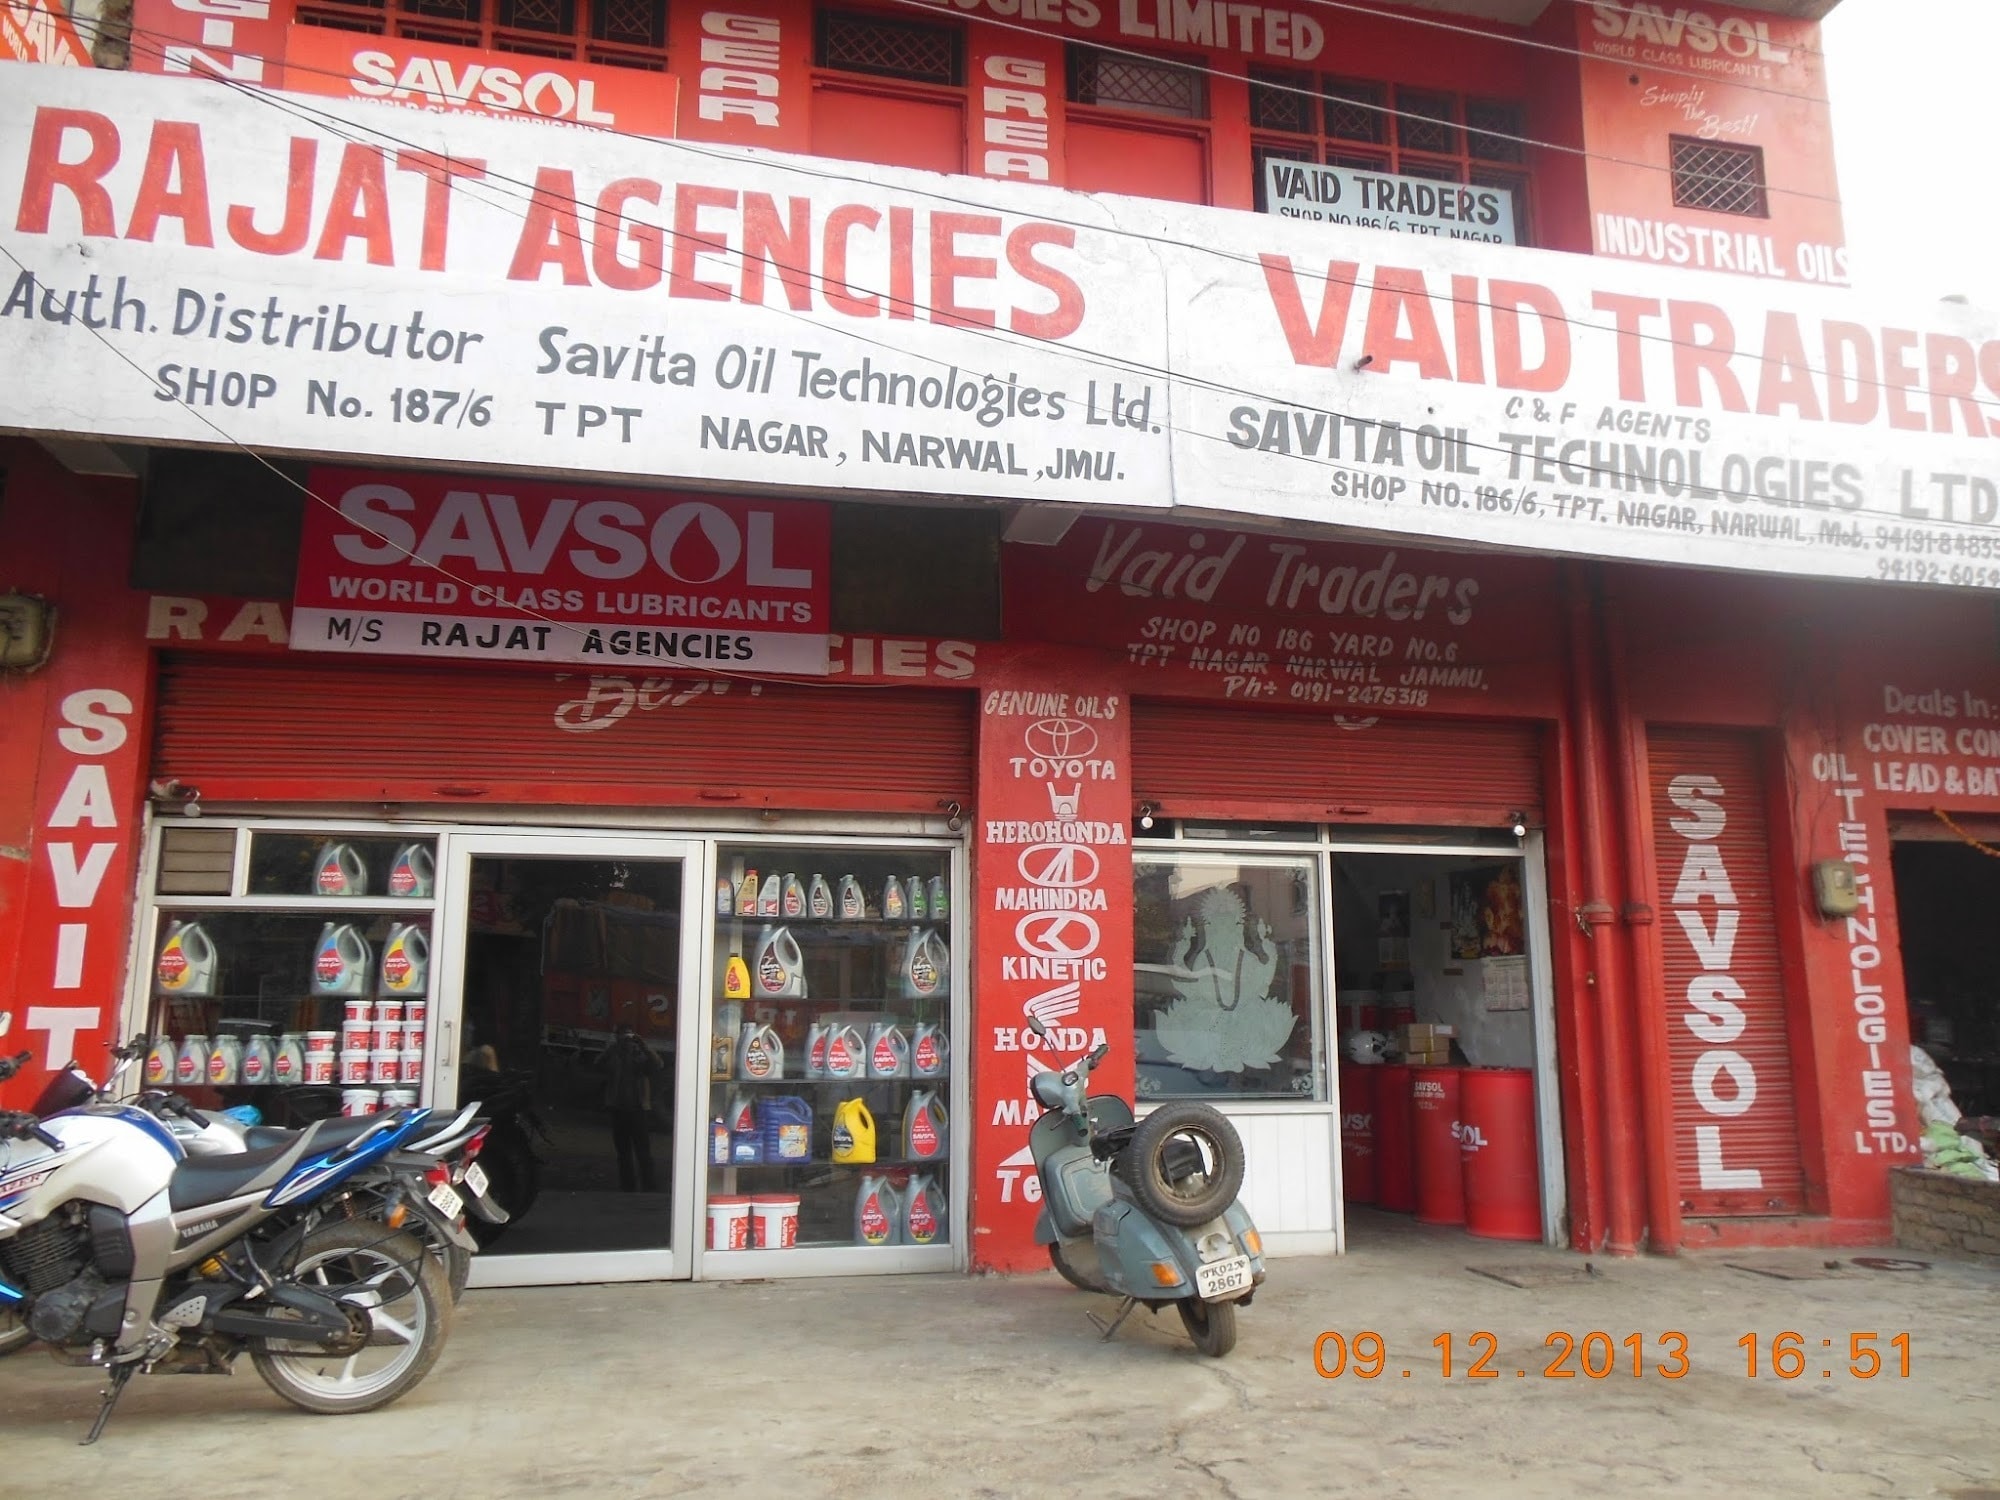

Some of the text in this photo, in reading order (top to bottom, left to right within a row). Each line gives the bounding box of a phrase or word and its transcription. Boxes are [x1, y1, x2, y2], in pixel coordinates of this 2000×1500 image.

[1119, 0, 1324, 62] LIMITED
[1591, 1, 1789, 64] SAVSOL
[699, 11, 780, 127] GEAR
[1592, 41, 1773, 79] WORLD CLASS LUBRICANTS
[350, 50, 615, 125] SAVSOL
[1640, 85, 1704, 106] Simply
[983, 56, 1049, 181] GREA
[1682, 104, 1705, 121] The
[1272, 165, 1500, 226] VAID TRADERS
[15, 105, 1087, 341] RAJAT AGENCIES
[1597, 213, 1849, 284] INDUSTRIAL OILS
[1257, 253, 1572, 393] VAID
[0, 271, 1163, 435] Auth. Distributor Savita Oil Technologies Ltd.
[153, 363, 277, 410] SHOP
[306, 380, 374, 419] No.
[390, 388, 494, 430] 187/6
[534, 400, 643, 444] TPT
[1505, 395, 1712, 444] C & F AGENTS
[1226, 405, 1404, 467] SAVITA
[1415, 424, 1480, 475] OIL
[1498, 431, 1864, 514] TECHNOLOGIES
[1331, 470, 1407, 501] SHOP
[1421, 480, 1469, 510] NO.
[1476, 485, 1545, 519] 186/6,
[1553, 493, 1608, 523] TPT.
[1617, 500, 1703, 535] NAGAR,
[1711, 509, 1815, 546] NARWAL,
[1819, 519, 1869, 550] Mob.
[332, 484, 812, 590] SAVSOL
[1085, 523, 1481, 626] Vaid Traders
[328, 575, 812, 623] WORLD CLASS LUBRICANTS
[327, 615, 754, 661] M/S RAJAT AGENCIES
[1141, 615, 1459, 662] SHOP NO 186 YARD NO.6
[1127, 642, 1489, 691] TPT NAGAR NARWAL JAMMU.
[984, 690, 1119, 720] GENUINE OILS
[1290, 680, 1430, 708] 0191-2475318
[1883, 684, 1999, 720] Deals In:
[1863, 722, 1949, 755] COVER
[1009, 757, 1116, 780] TOYOTA
[1812, 752, 1858, 782] OIL
[1873, 761, 1941, 793] LEAD
[986, 821, 1127, 845] HEROHONDA
[26, 688, 133, 1071] SAVIT
[994, 887, 1108, 911] MAHINDRA
[1002, 956, 1107, 981] KINETIC
[1667, 774, 1763, 1190] SAVSOL
[993, 1027, 1108, 1052] HONDA
[1414, 1081, 1444, 1092] SAVSOL
[1855, 1130, 1918, 1155] LTD.
[181, 1219, 219, 1239] YAMAHA
[1208, 1273, 1243, 1293] 2867
